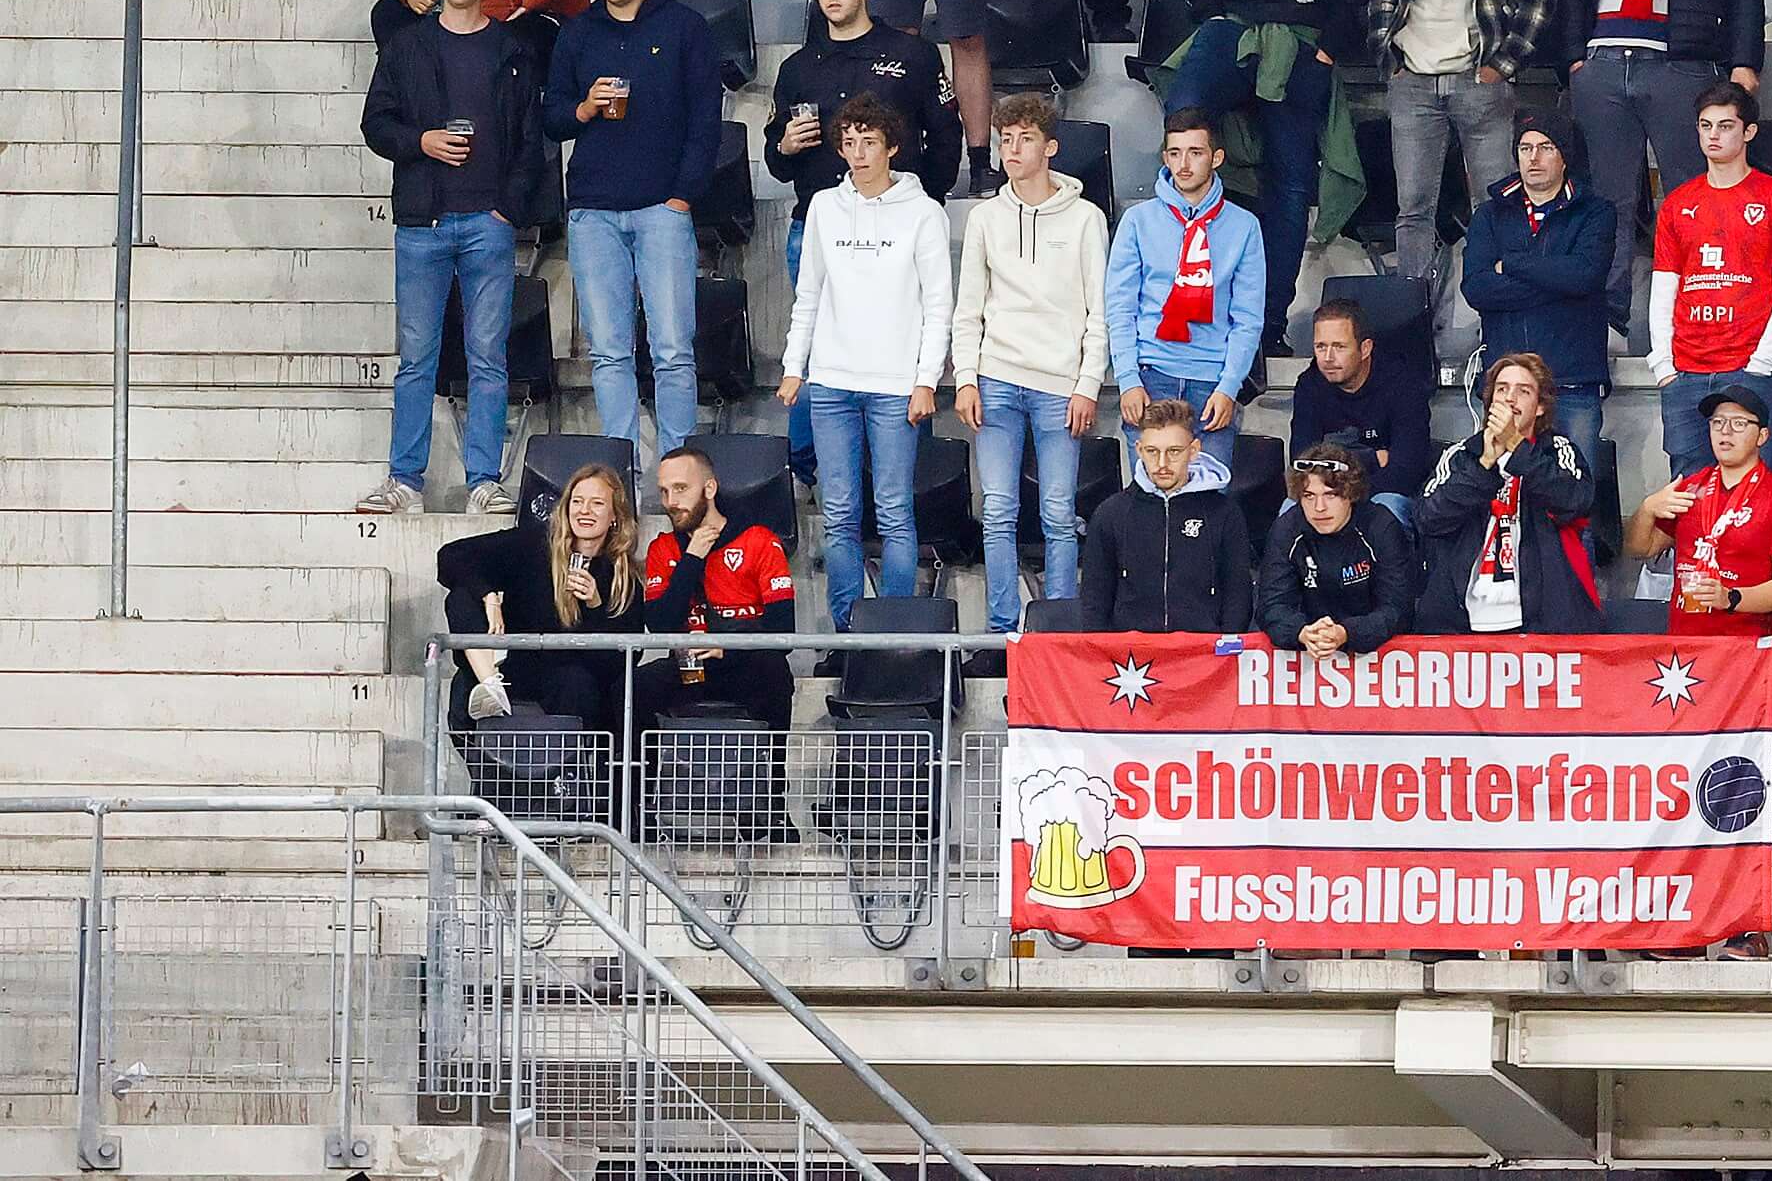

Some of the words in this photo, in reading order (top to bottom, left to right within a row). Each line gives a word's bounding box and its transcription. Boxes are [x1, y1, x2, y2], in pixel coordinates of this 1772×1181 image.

[366, 204, 387, 222] 14
[1689, 305, 1735, 323] MBPI
[360, 363, 380, 380] 13
[357, 521, 377, 539] 12
[1237, 649, 1583, 709] REISEGRUPPE
[352, 684, 370, 701] 11
[1113, 746, 1690, 823] schönwetterfans
[1174, 865, 1526, 924] FussballClub
[1536, 866, 1694, 925] Vaduz
